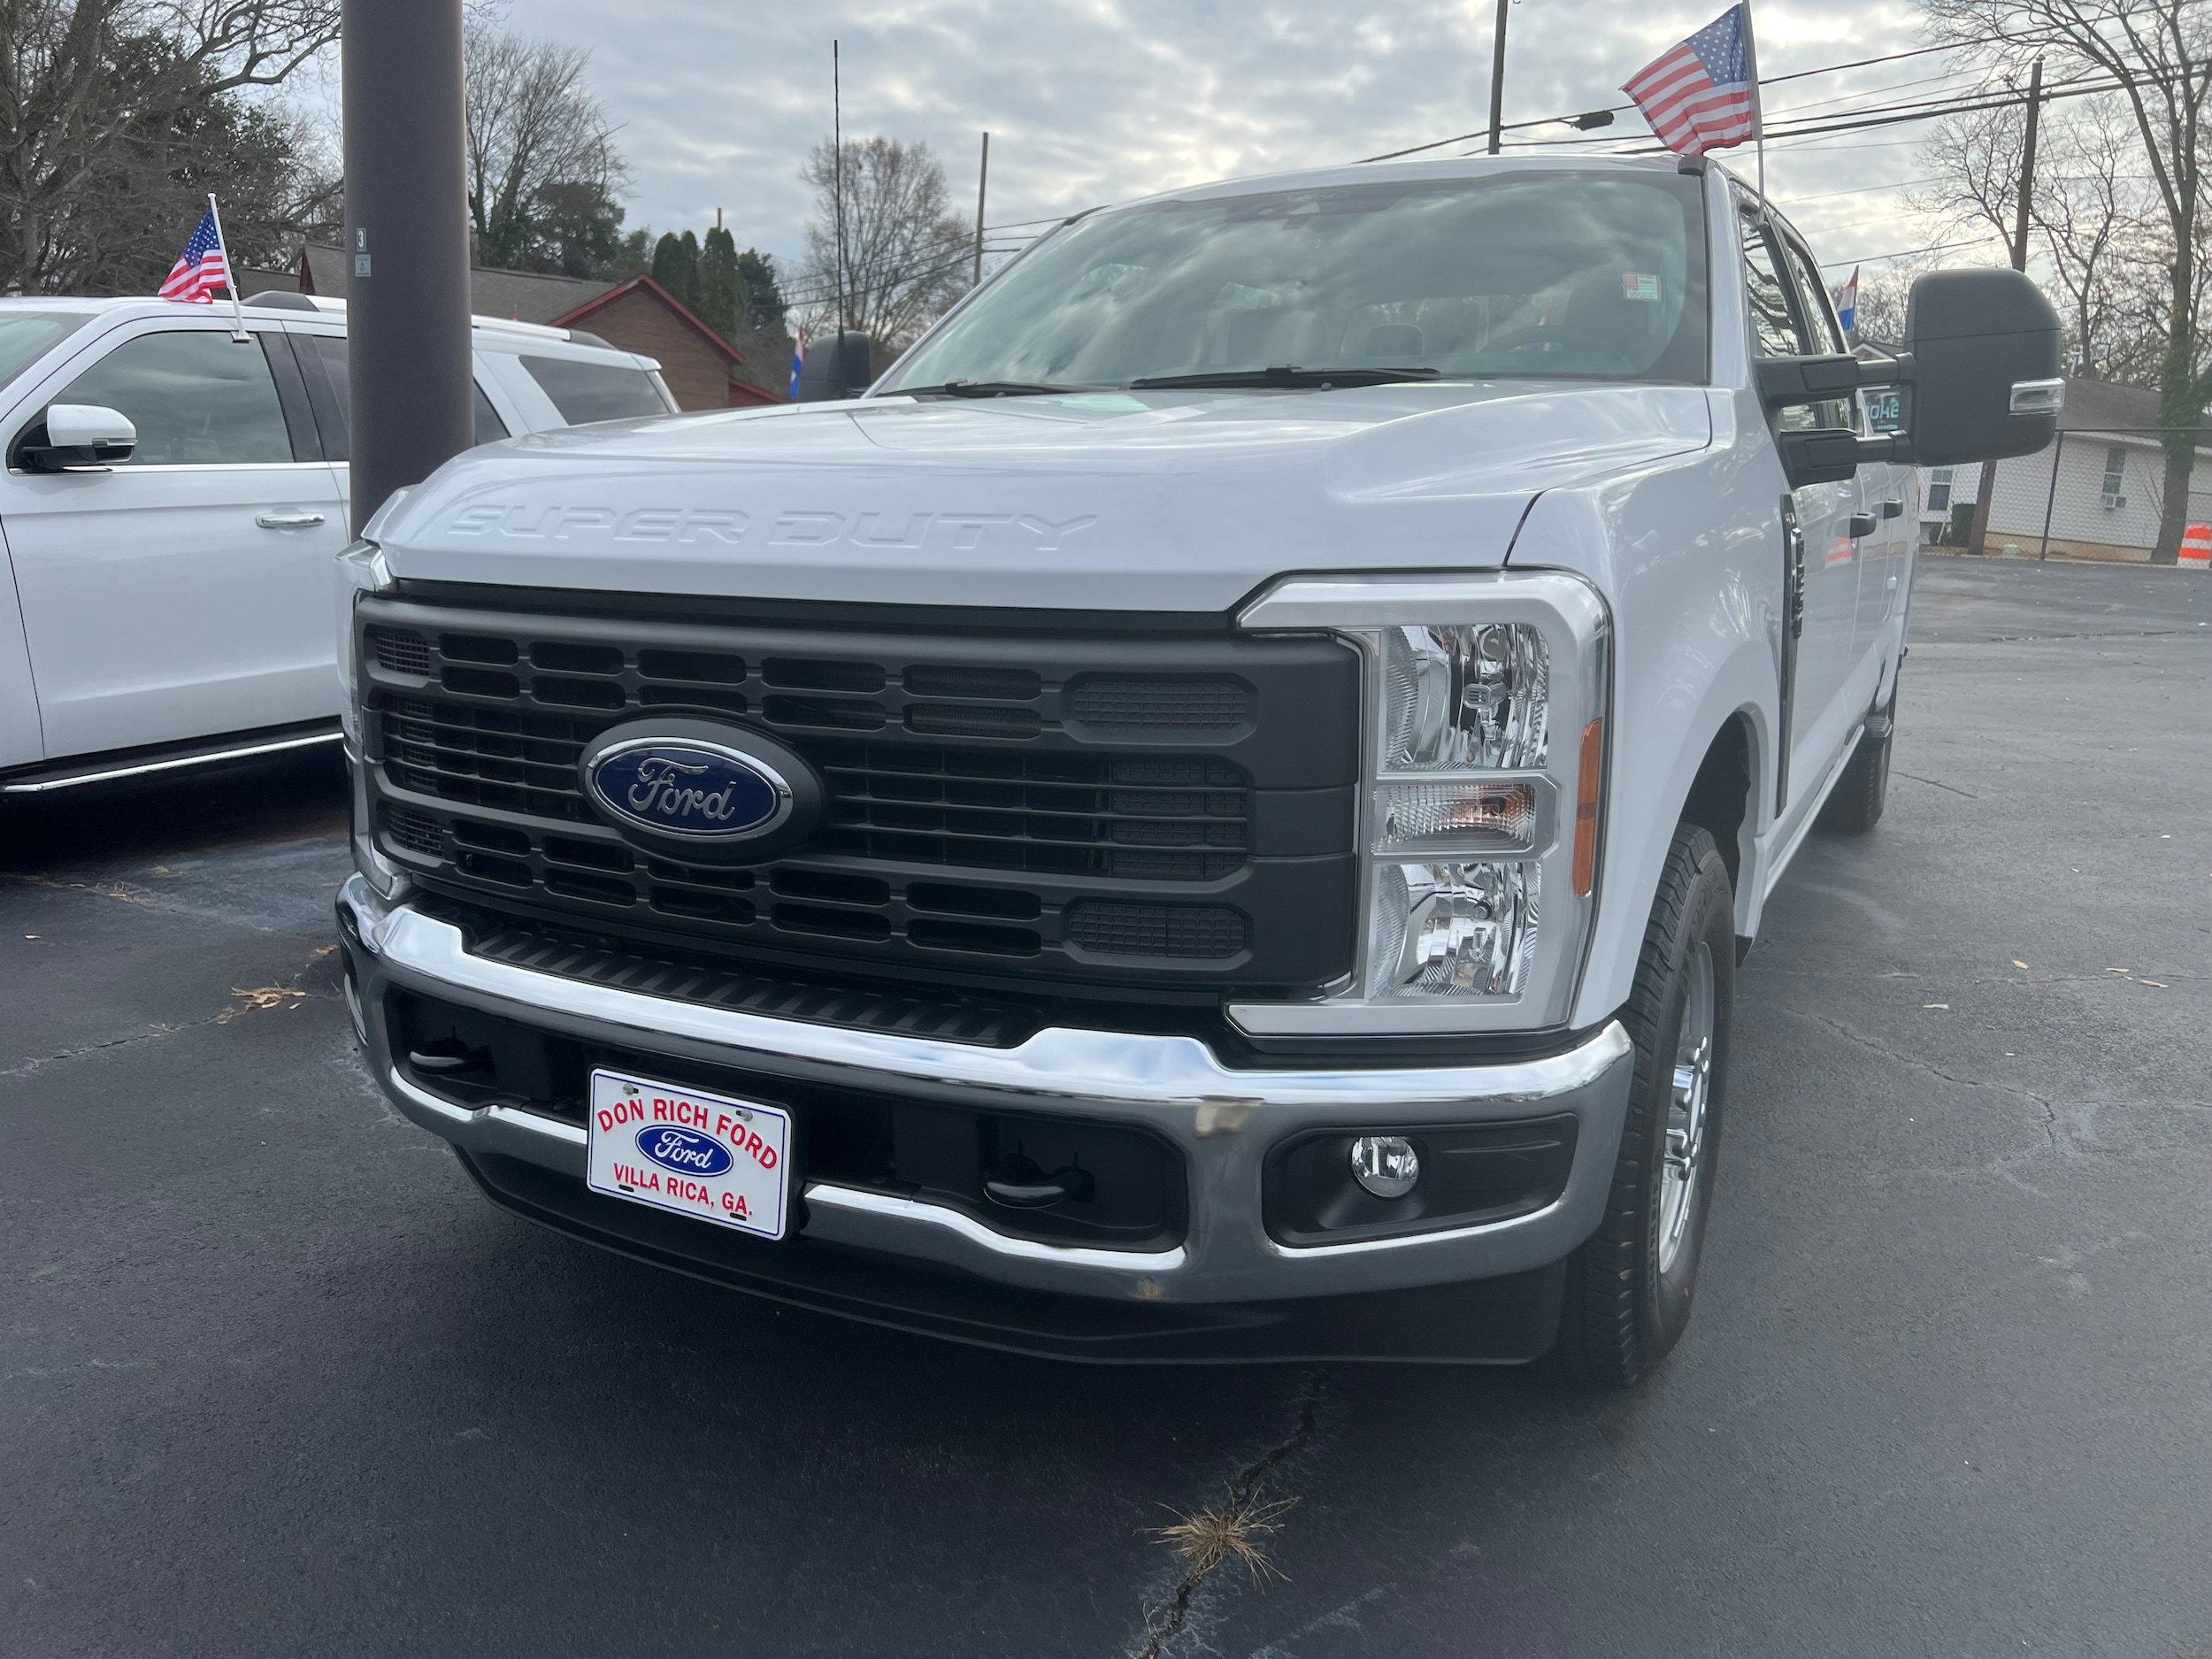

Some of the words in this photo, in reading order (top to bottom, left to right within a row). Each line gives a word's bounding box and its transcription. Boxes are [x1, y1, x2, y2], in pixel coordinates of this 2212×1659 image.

[357, 230, 365, 248] 3
[448, 504, 750, 544] SUPER
[766, 511, 1098, 551] DUTY
[627, 757, 736, 821] Ford
[597, 1099, 644, 1133] DON
[653, 1098, 709, 1129] RICH
[716, 1115, 778, 1170] FORD
[654, 1131, 714, 1169] Ford
[613, 1163, 660, 1191] VILLA
[666, 1177, 715, 1210] RICA,
[722, 1192, 754, 1216] GA.
